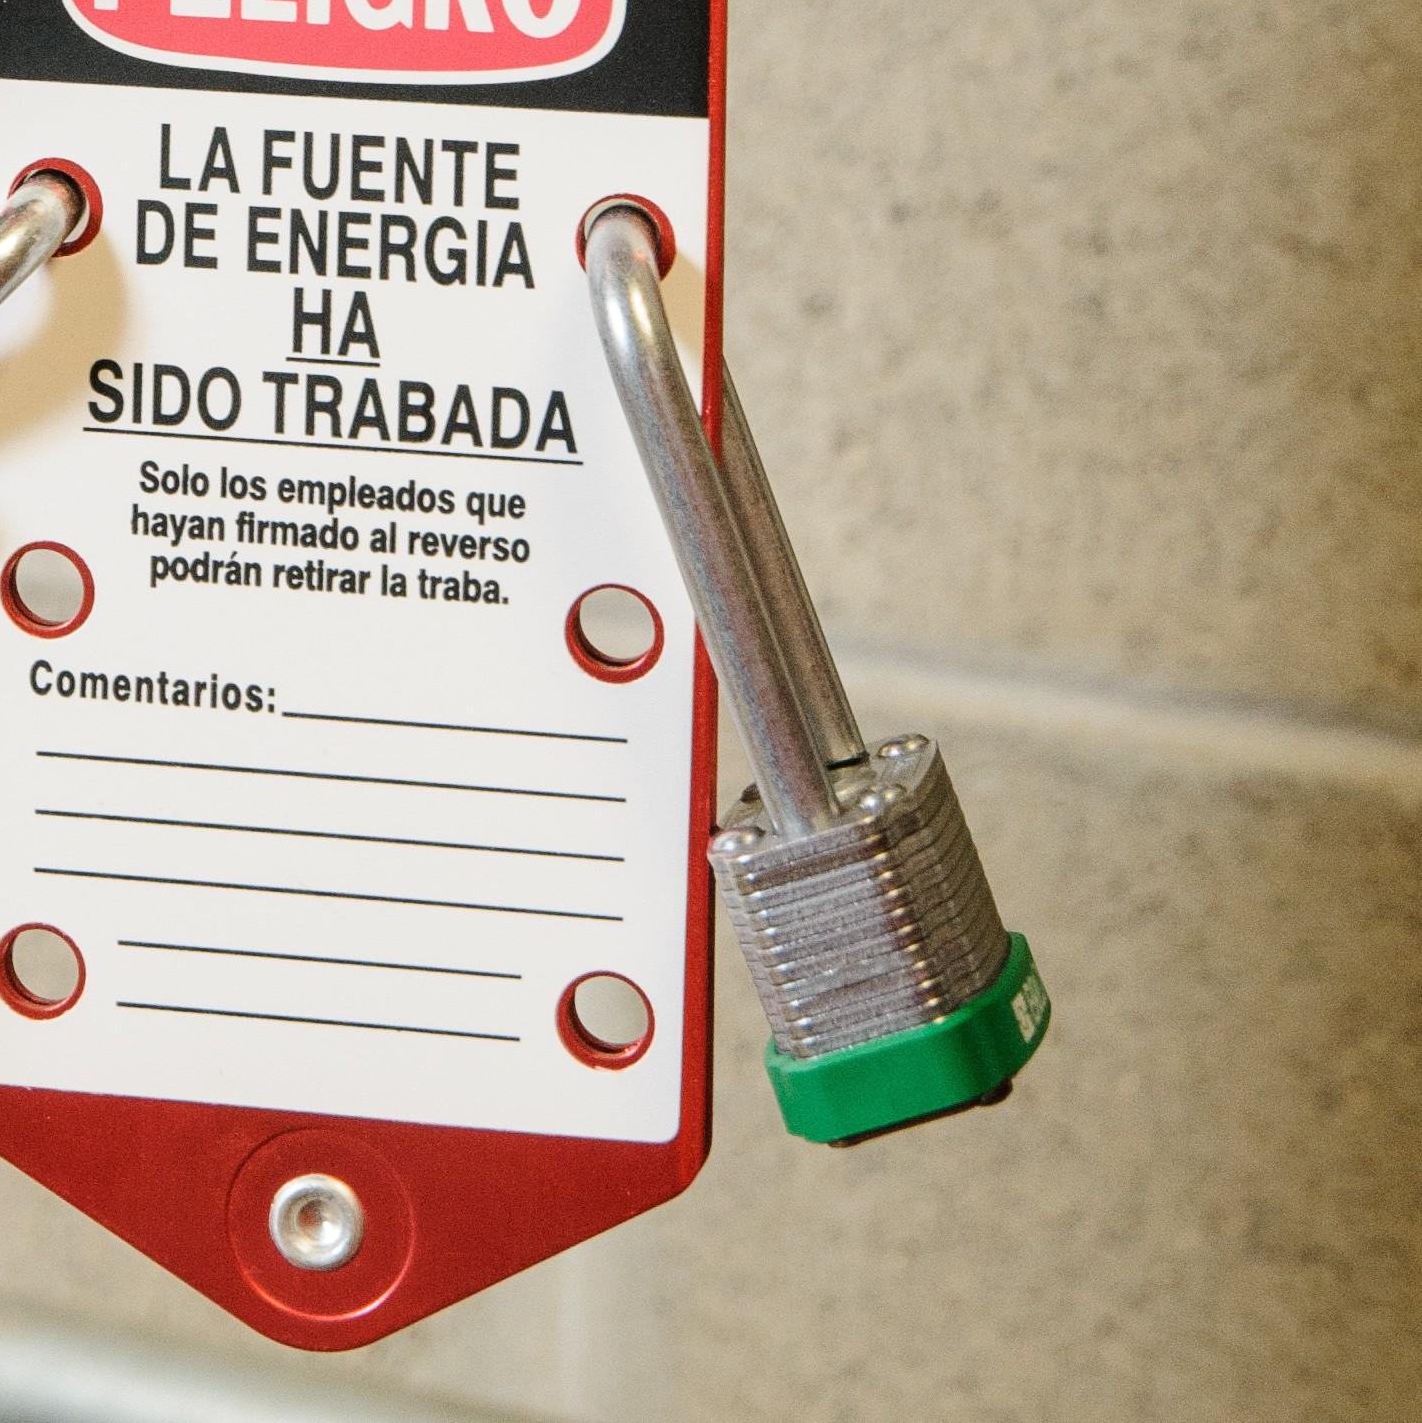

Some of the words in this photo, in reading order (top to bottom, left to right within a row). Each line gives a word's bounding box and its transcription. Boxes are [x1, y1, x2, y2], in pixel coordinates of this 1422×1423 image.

[160, 123, 240, 193] LA
[262, 129, 520, 210] FUENTE
[136, 199, 218, 269] DE
[247, 206, 535, 289] ENERGIA
[293, 287, 380, 359] HA
[88, 358, 242, 431] SIDO
[263, 371, 577, 454] TRABADA
[139, 460, 209, 497] Solo
[220, 466, 266, 501] los
[278, 475, 456, 515] empleados
[466, 491, 527, 525] que
[131, 504, 225, 546] hayan
[236, 510, 359, 551] firmado
[369, 522, 397, 554] al
[408, 530, 531, 563] reverso
[150, 551, 262, 587] podrán
[273, 560, 371, 596] retirar
[381, 564, 408, 598] la
[418, 568, 510, 605] traba.
[29, 659, 275, 713] Comentarios:
